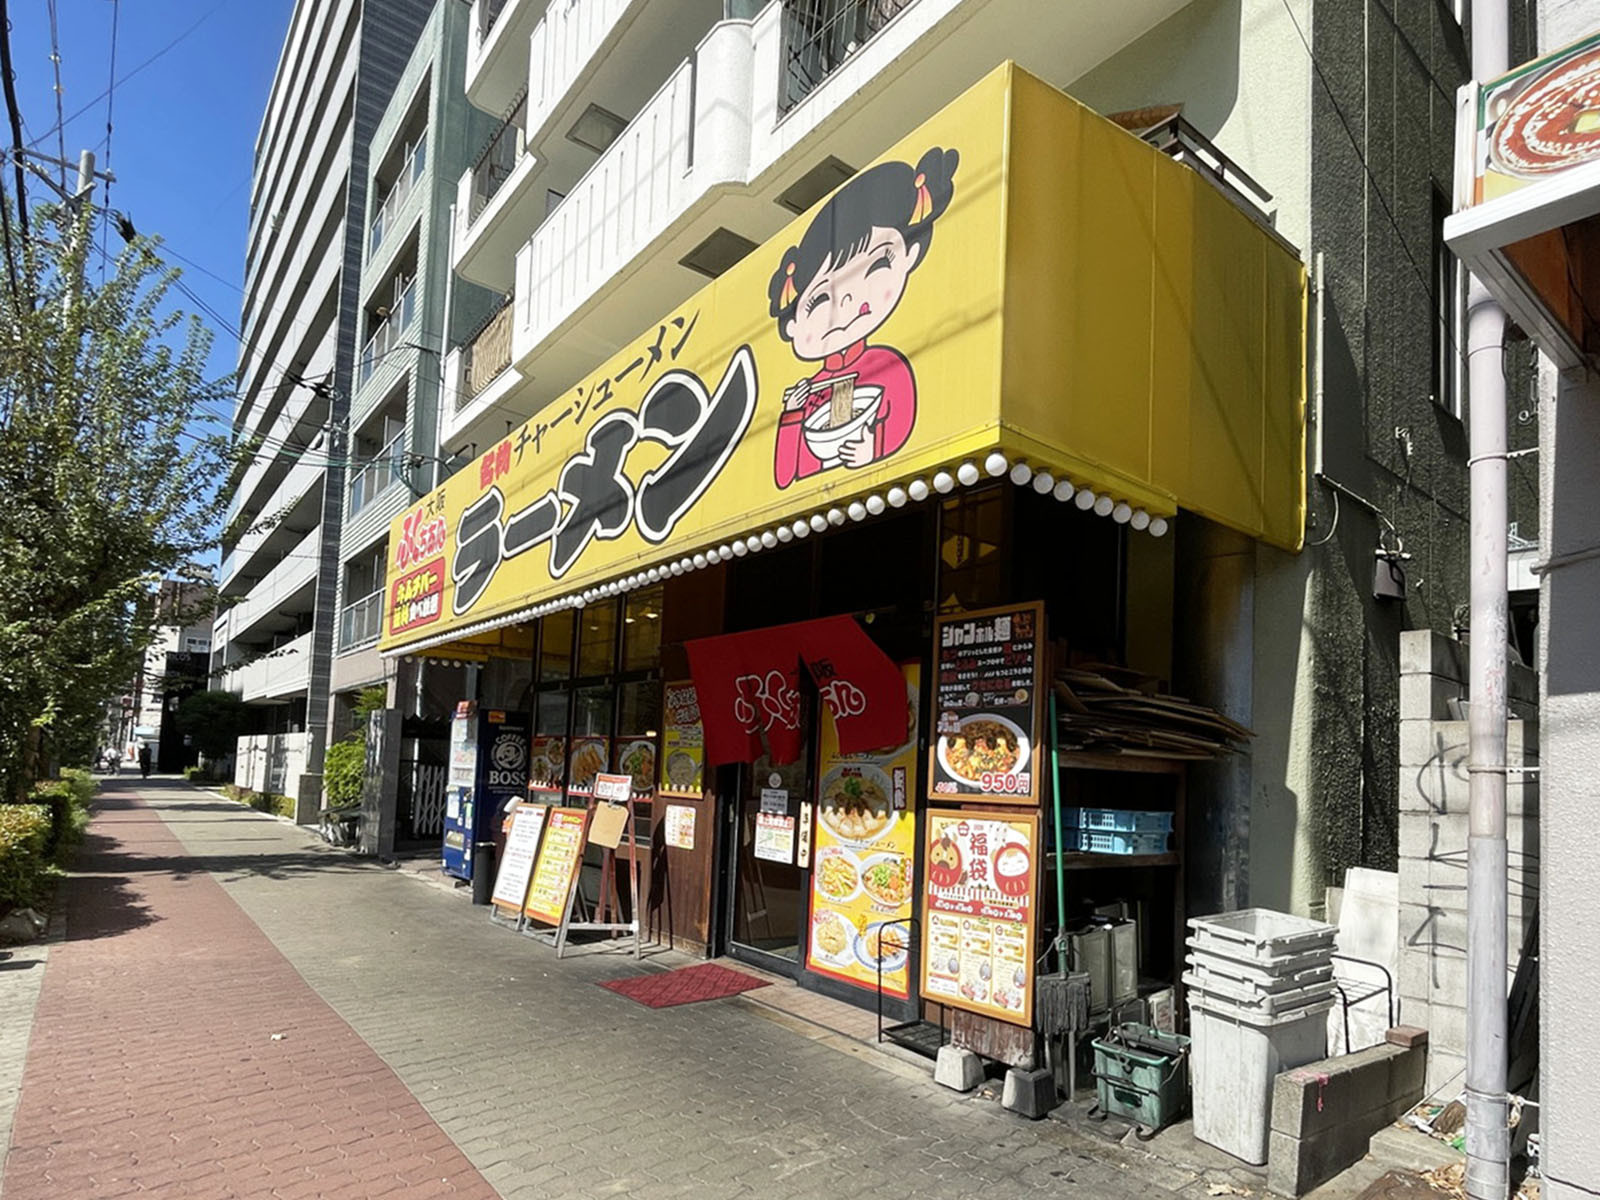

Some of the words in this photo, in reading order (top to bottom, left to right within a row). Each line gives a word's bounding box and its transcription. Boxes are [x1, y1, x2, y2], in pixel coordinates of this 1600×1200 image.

[452, 343, 758, 616] ラーメン
[426, 488, 446, 519] 大阪
[981, 772, 1030, 794] 950円
[969, 831, 989, 882] 福袋
